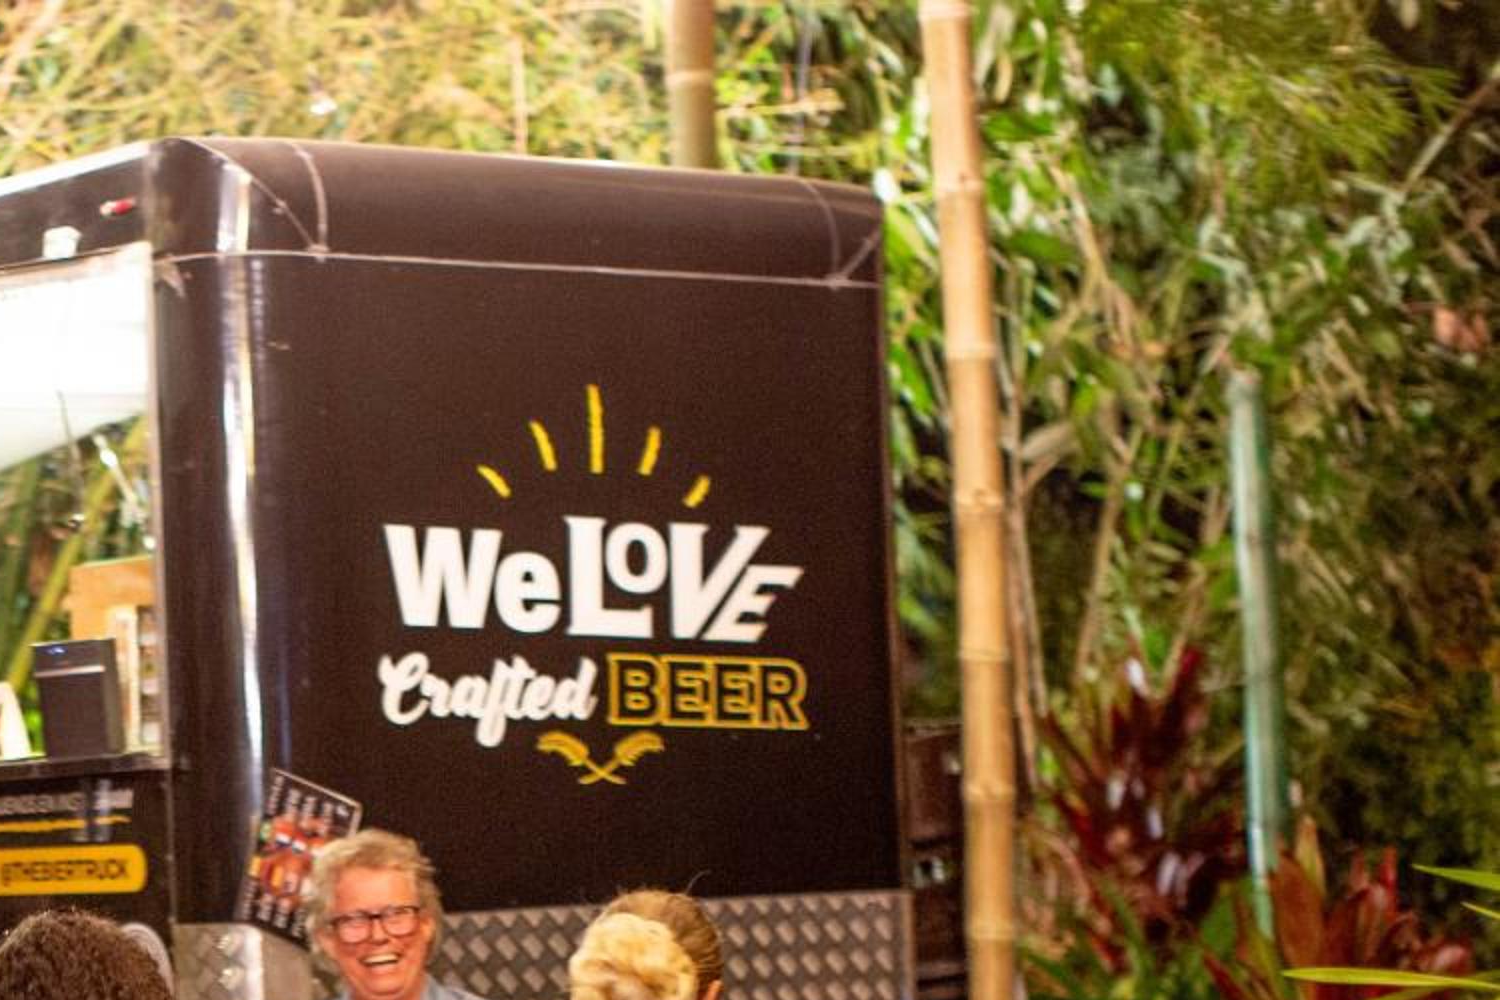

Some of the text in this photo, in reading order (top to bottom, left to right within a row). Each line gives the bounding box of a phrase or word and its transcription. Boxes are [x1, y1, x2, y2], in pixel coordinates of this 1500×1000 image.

[384, 524, 561, 634] We
[378, 652, 810, 747] Crafted BEER
